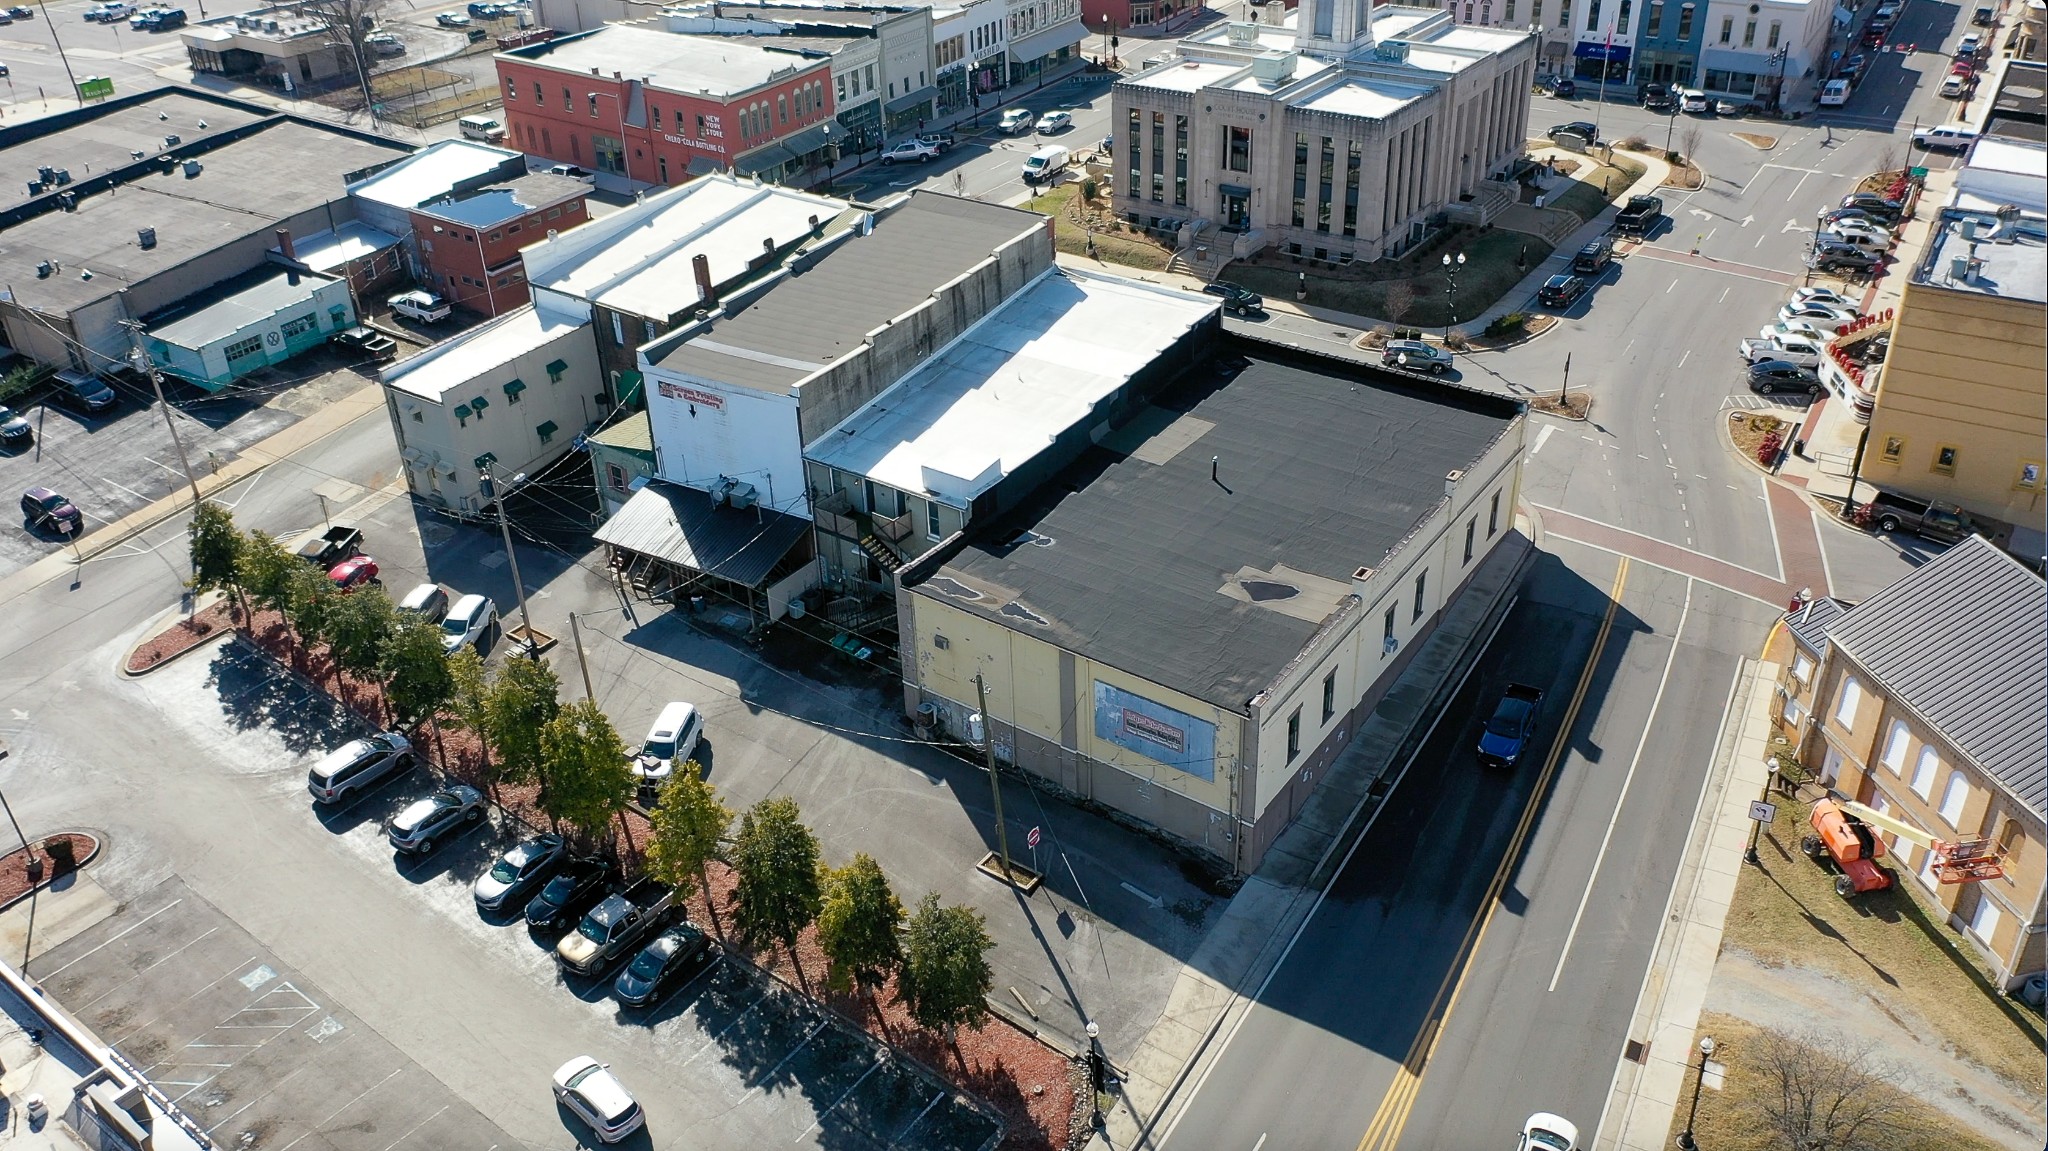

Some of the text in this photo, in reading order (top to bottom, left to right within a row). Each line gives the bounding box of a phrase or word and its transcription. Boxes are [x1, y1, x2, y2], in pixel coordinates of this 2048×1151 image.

[974, 44, 1000, 59] MESHED
[705, 121, 721, 129] YORK
[705, 128, 724, 138] STORE
